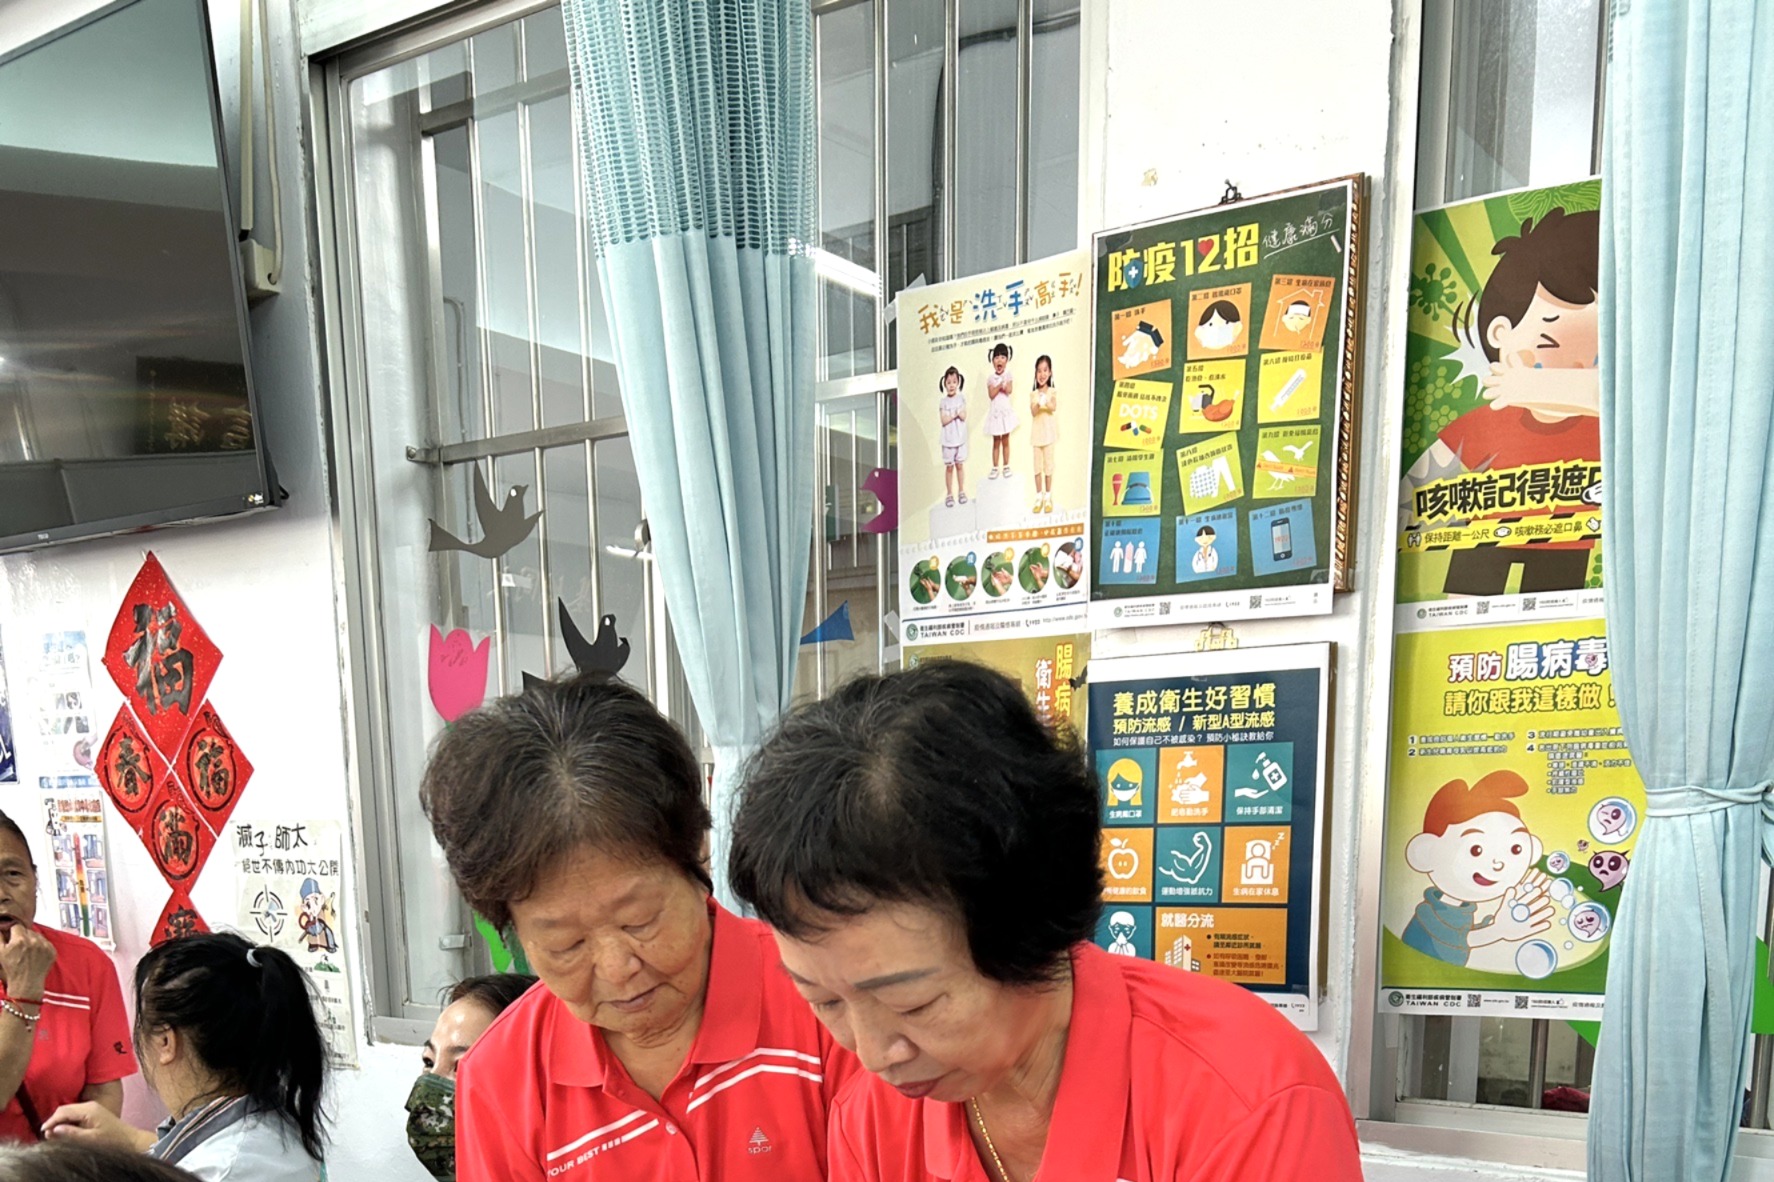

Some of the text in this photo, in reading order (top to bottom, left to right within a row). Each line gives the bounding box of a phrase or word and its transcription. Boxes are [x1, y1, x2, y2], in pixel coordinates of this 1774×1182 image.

[1262, 213, 1333, 249] 健康滿分
[1107, 223, 1259, 292] 防疫12招
[1119, 404, 1158, 420] DOTS
[1424, 520, 1583, 545] 保持距離一公尺 咳嗽務必遮口鼻
[123, 602, 194, 716] 福
[1448, 636, 1608, 683] 預防腸病毒
[1113, 683, 1276, 716] 養成衛生好習慣
[1113, 718, 1172, 735] 預防流感
[1192, 711, 1275, 731] 新型A型流感
[1161, 912, 1215, 929] 就醫分流
[576, 1146, 600, 1165] BEST
